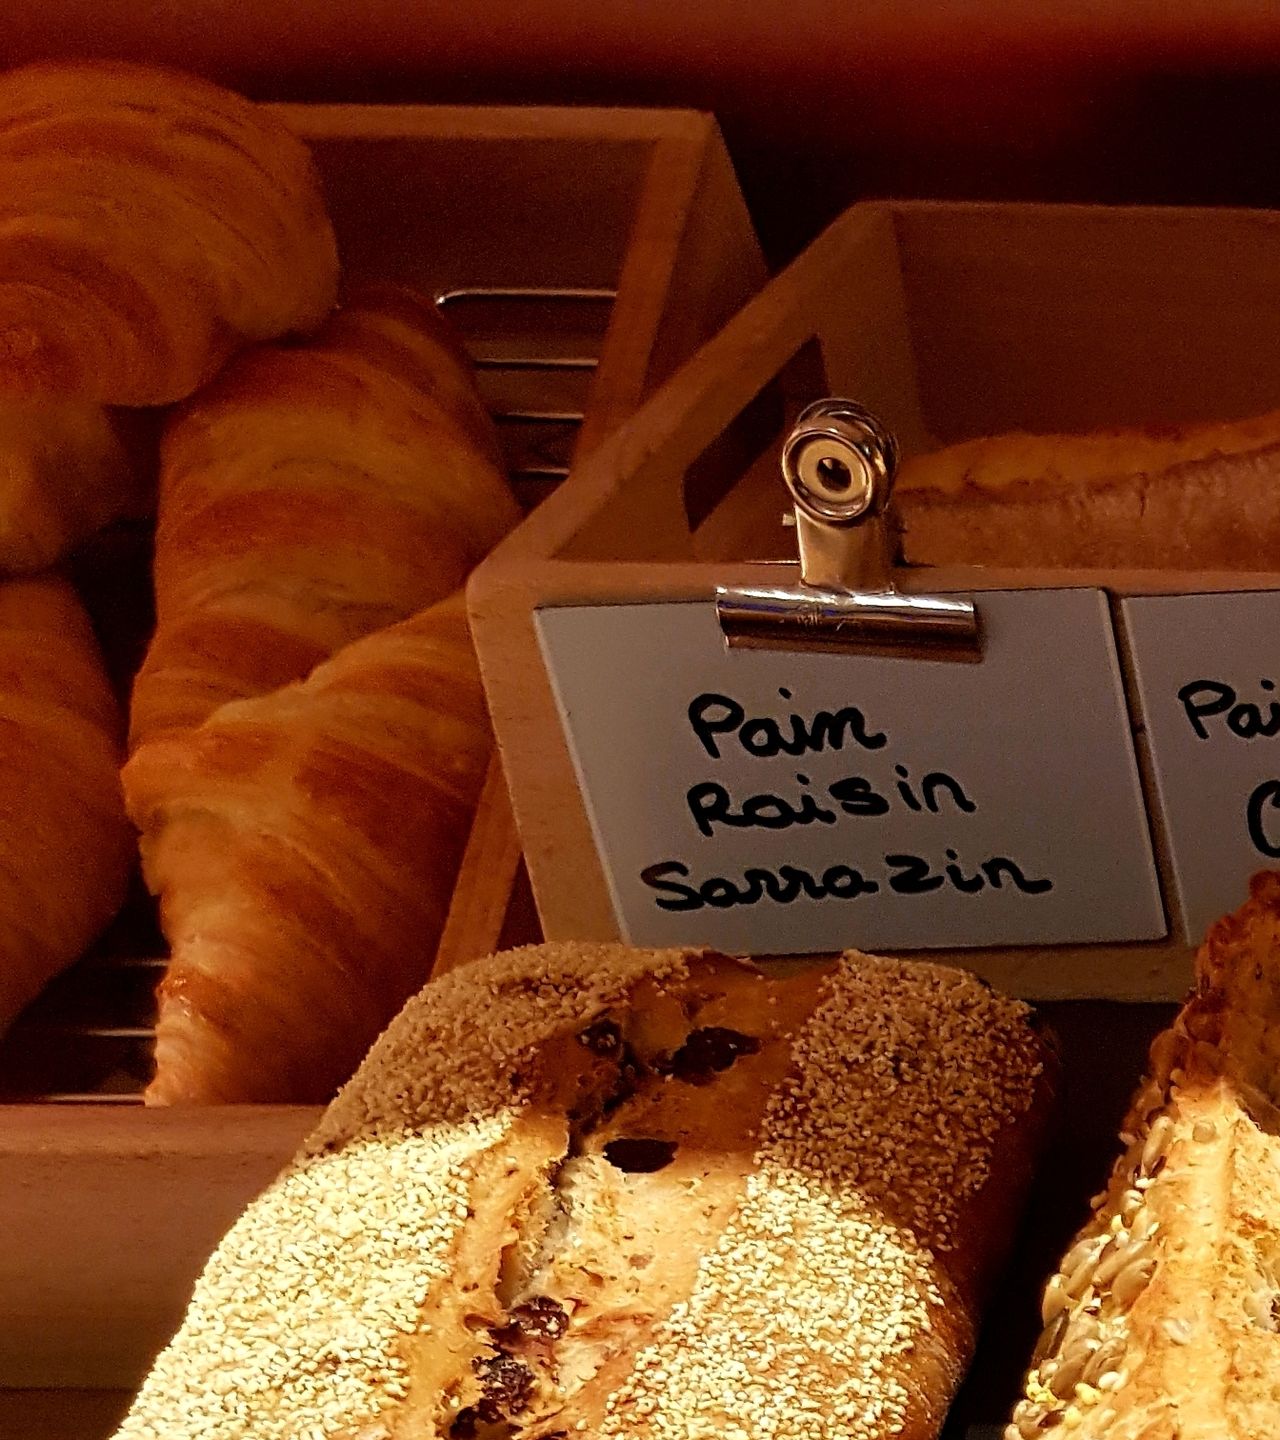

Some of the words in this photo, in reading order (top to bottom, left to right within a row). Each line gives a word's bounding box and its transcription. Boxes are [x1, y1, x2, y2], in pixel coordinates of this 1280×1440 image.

[688, 686, 887, 759] Pain
[687, 764, 977, 837] Raisin
[641, 849, 1052, 912] Sarrazin
